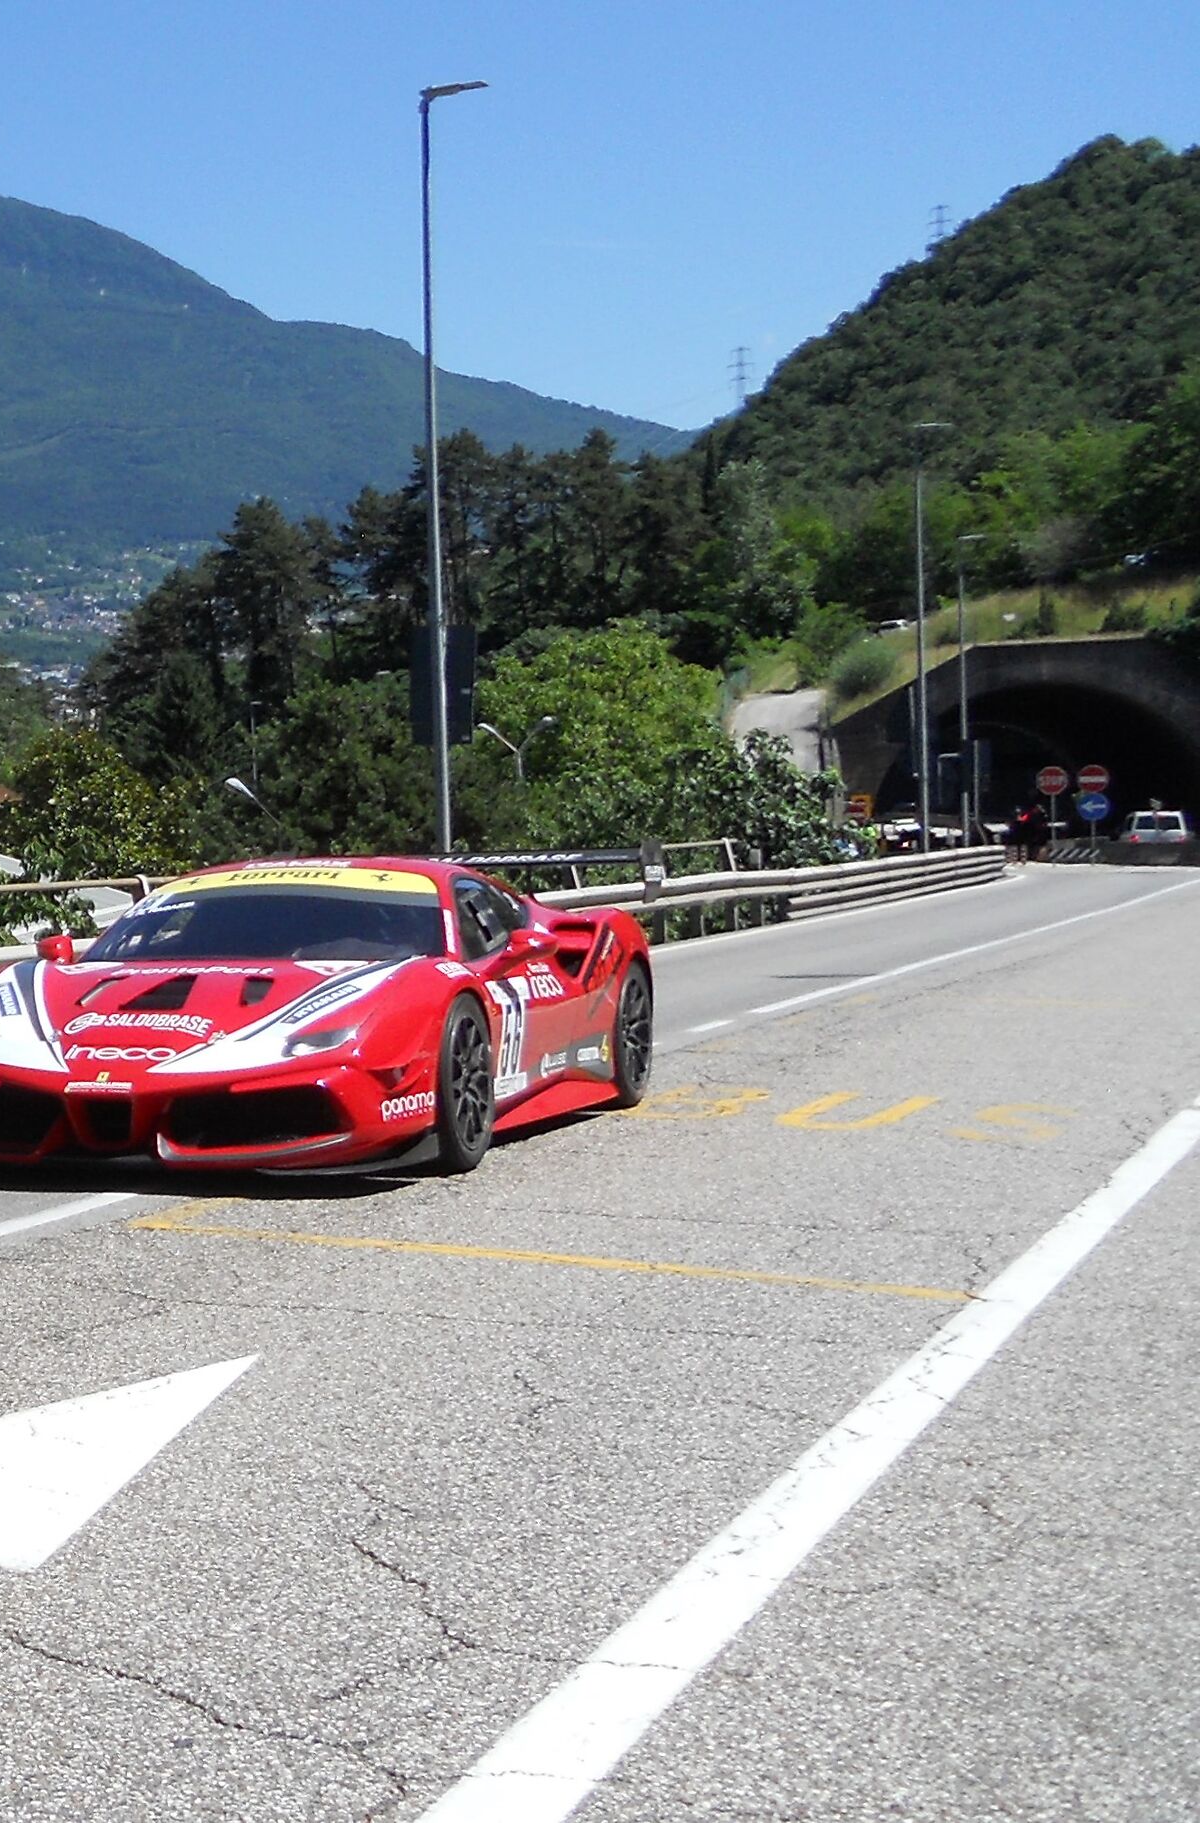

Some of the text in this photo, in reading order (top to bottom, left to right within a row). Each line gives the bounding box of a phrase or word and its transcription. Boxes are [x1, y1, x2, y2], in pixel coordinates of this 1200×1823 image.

[227, 870, 341, 882] Ferrari
[104, 1013, 213, 1034] SALDOBRASE
[64, 1044, 177, 1061] ineco
[618, 1086, 1076, 1142] BUS
